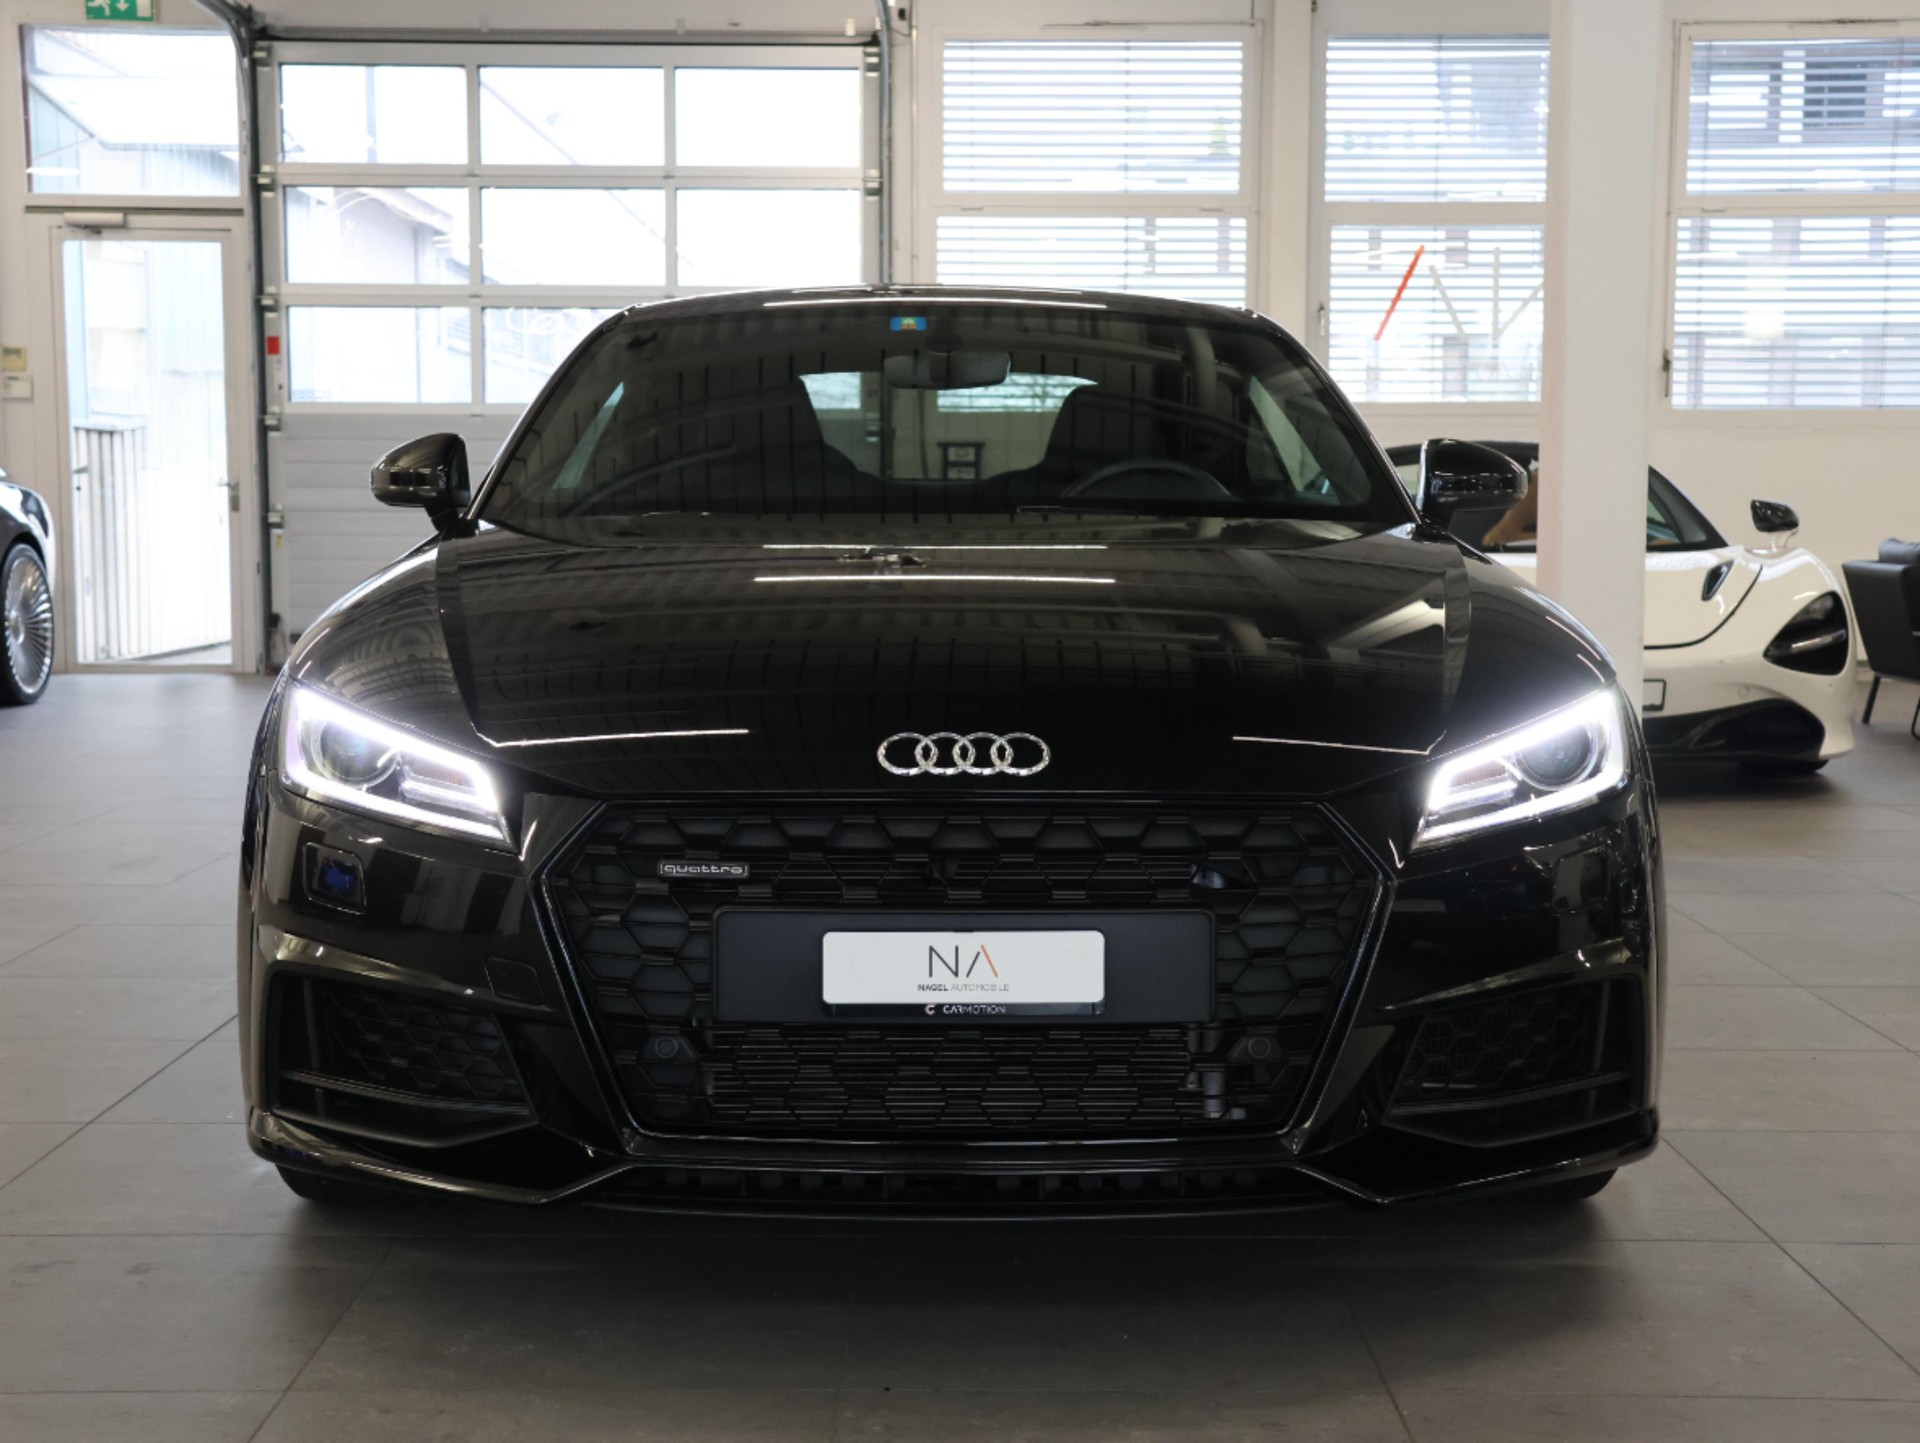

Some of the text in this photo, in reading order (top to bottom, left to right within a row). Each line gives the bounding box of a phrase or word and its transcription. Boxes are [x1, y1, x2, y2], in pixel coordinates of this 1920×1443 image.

[663, 864, 743, 876] quattro
[928, 944, 998, 978] NA
[917, 983, 1009, 992] NAGEL AUTOMOBLE
[943, 1005, 1006, 1015] CARMOTION
